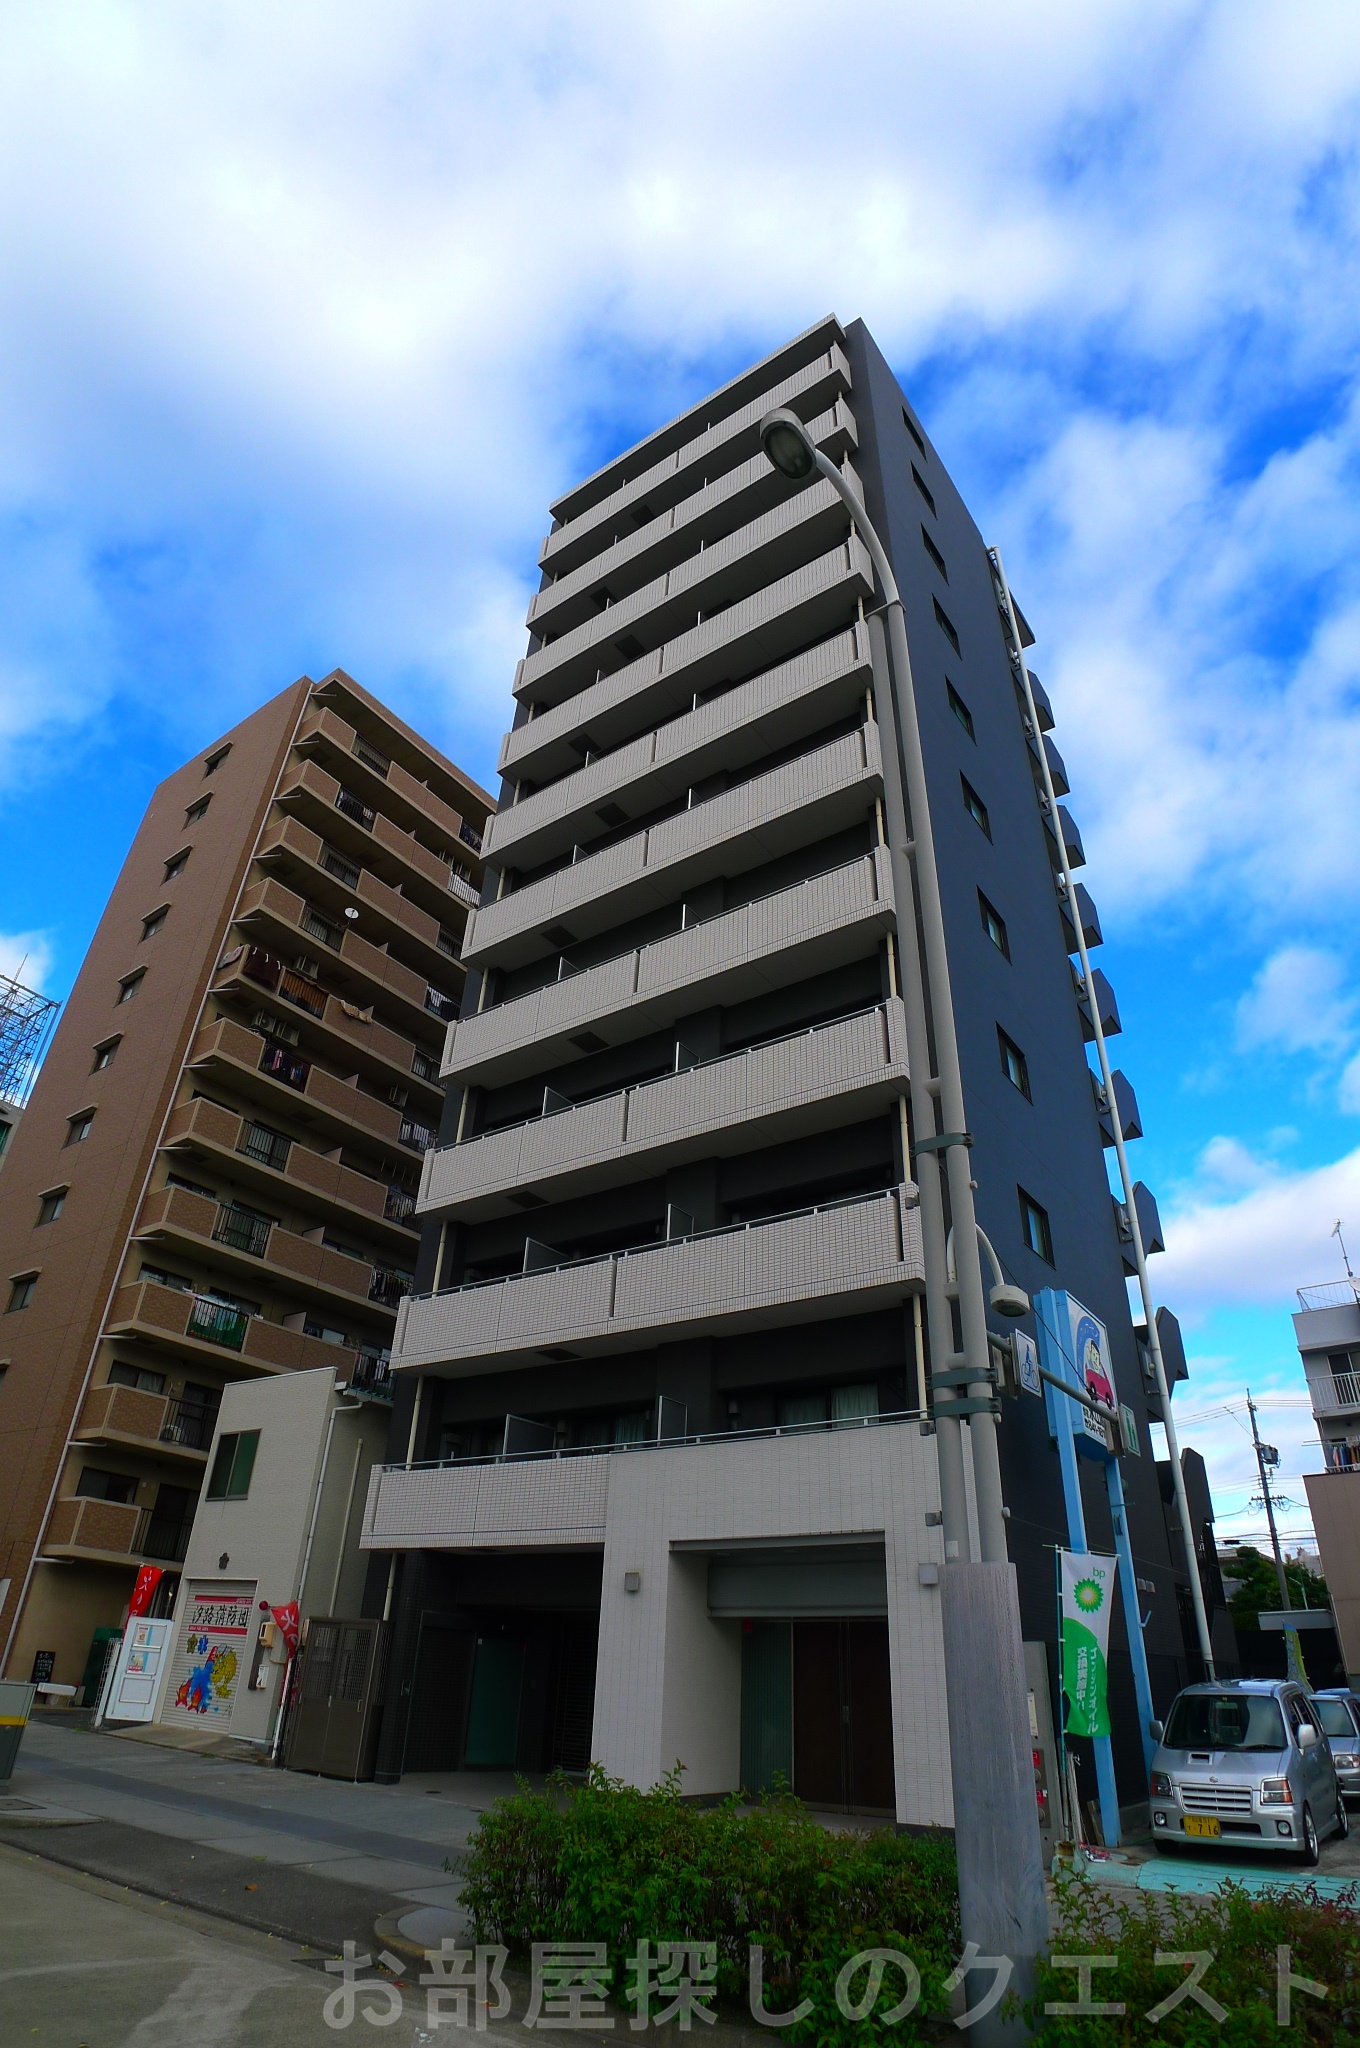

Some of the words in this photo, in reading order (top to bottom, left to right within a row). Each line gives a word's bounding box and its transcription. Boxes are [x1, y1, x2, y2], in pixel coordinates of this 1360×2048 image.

[1092, 1566, 1106, 1579] bp
[1087, 1646, 1099, 1735] エンジンオイル
